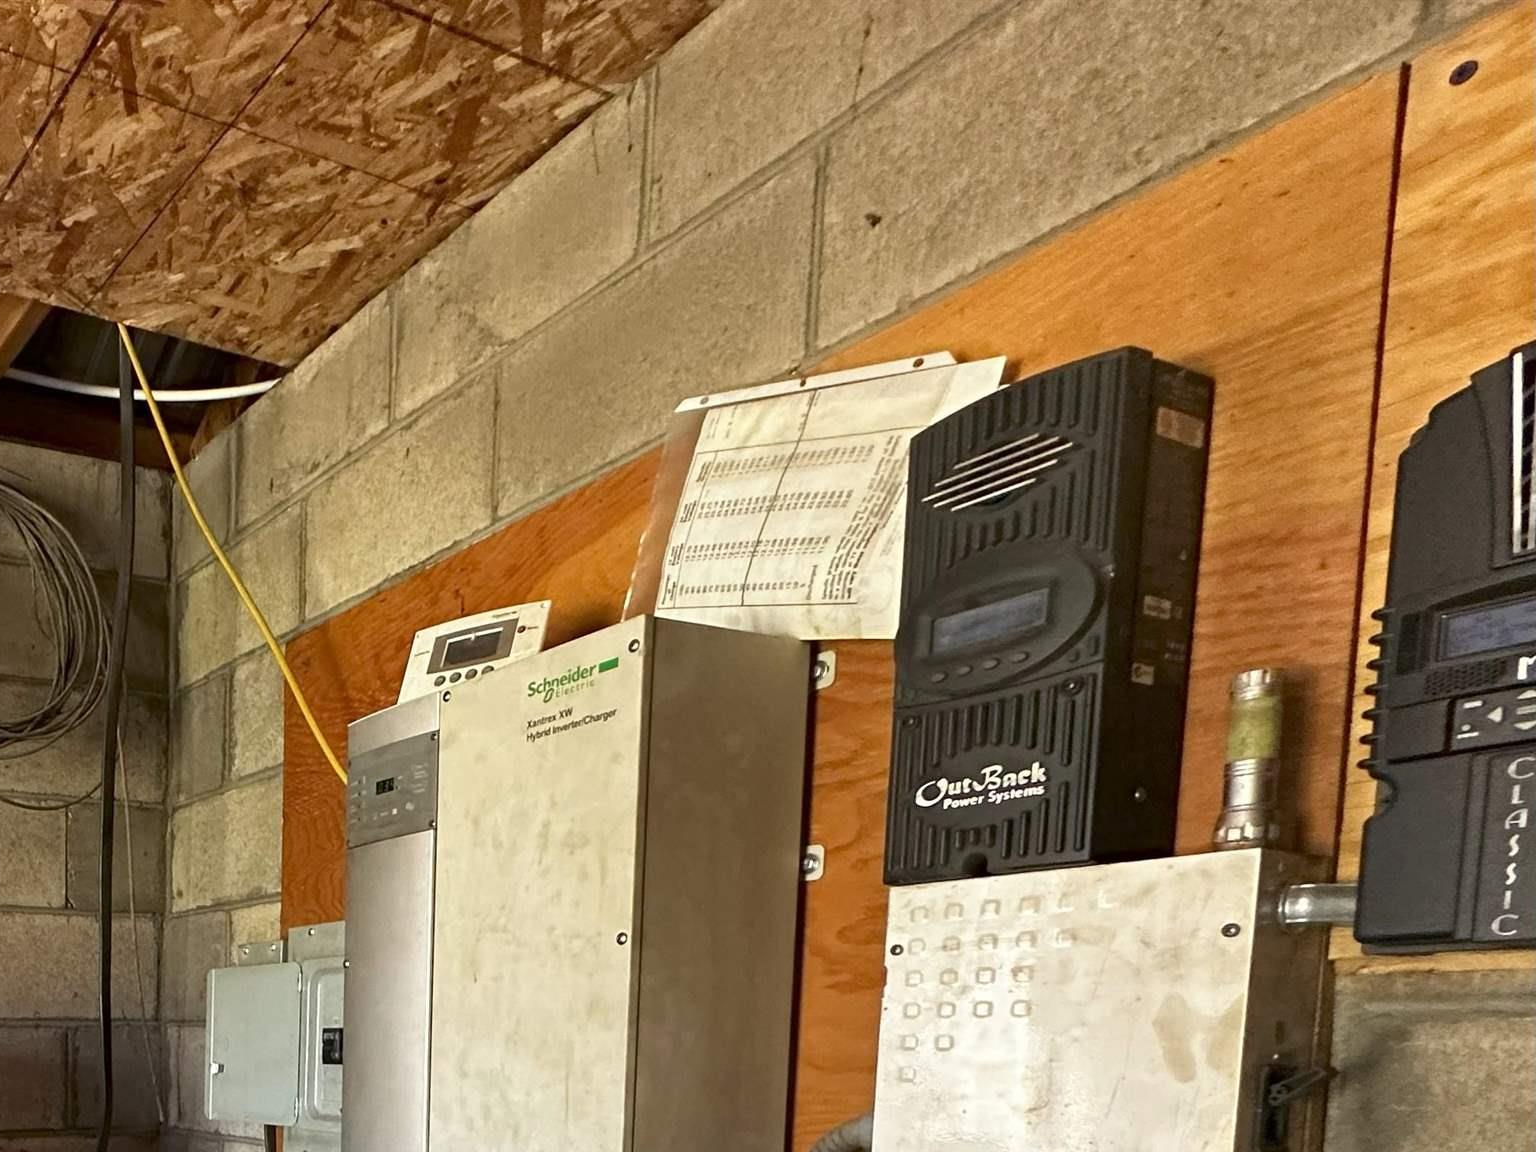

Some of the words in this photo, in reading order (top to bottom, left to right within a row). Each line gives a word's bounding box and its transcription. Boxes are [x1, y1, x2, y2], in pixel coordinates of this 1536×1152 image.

[527, 664, 597, 699] Schneider
[556, 680, 595, 698] Electric
[526, 727, 551, 743] Hybrid
[552, 709, 617, 735] Inverter/Charger
[527, 713, 556, 729] Xantrex
[559, 708, 573, 719] XW
[915, 762, 1048, 807] OutBack
[943, 796, 984, 810] Power
[988, 785, 1045, 804] Systems
[1490, 756, 1535, 936] CLASSIC
